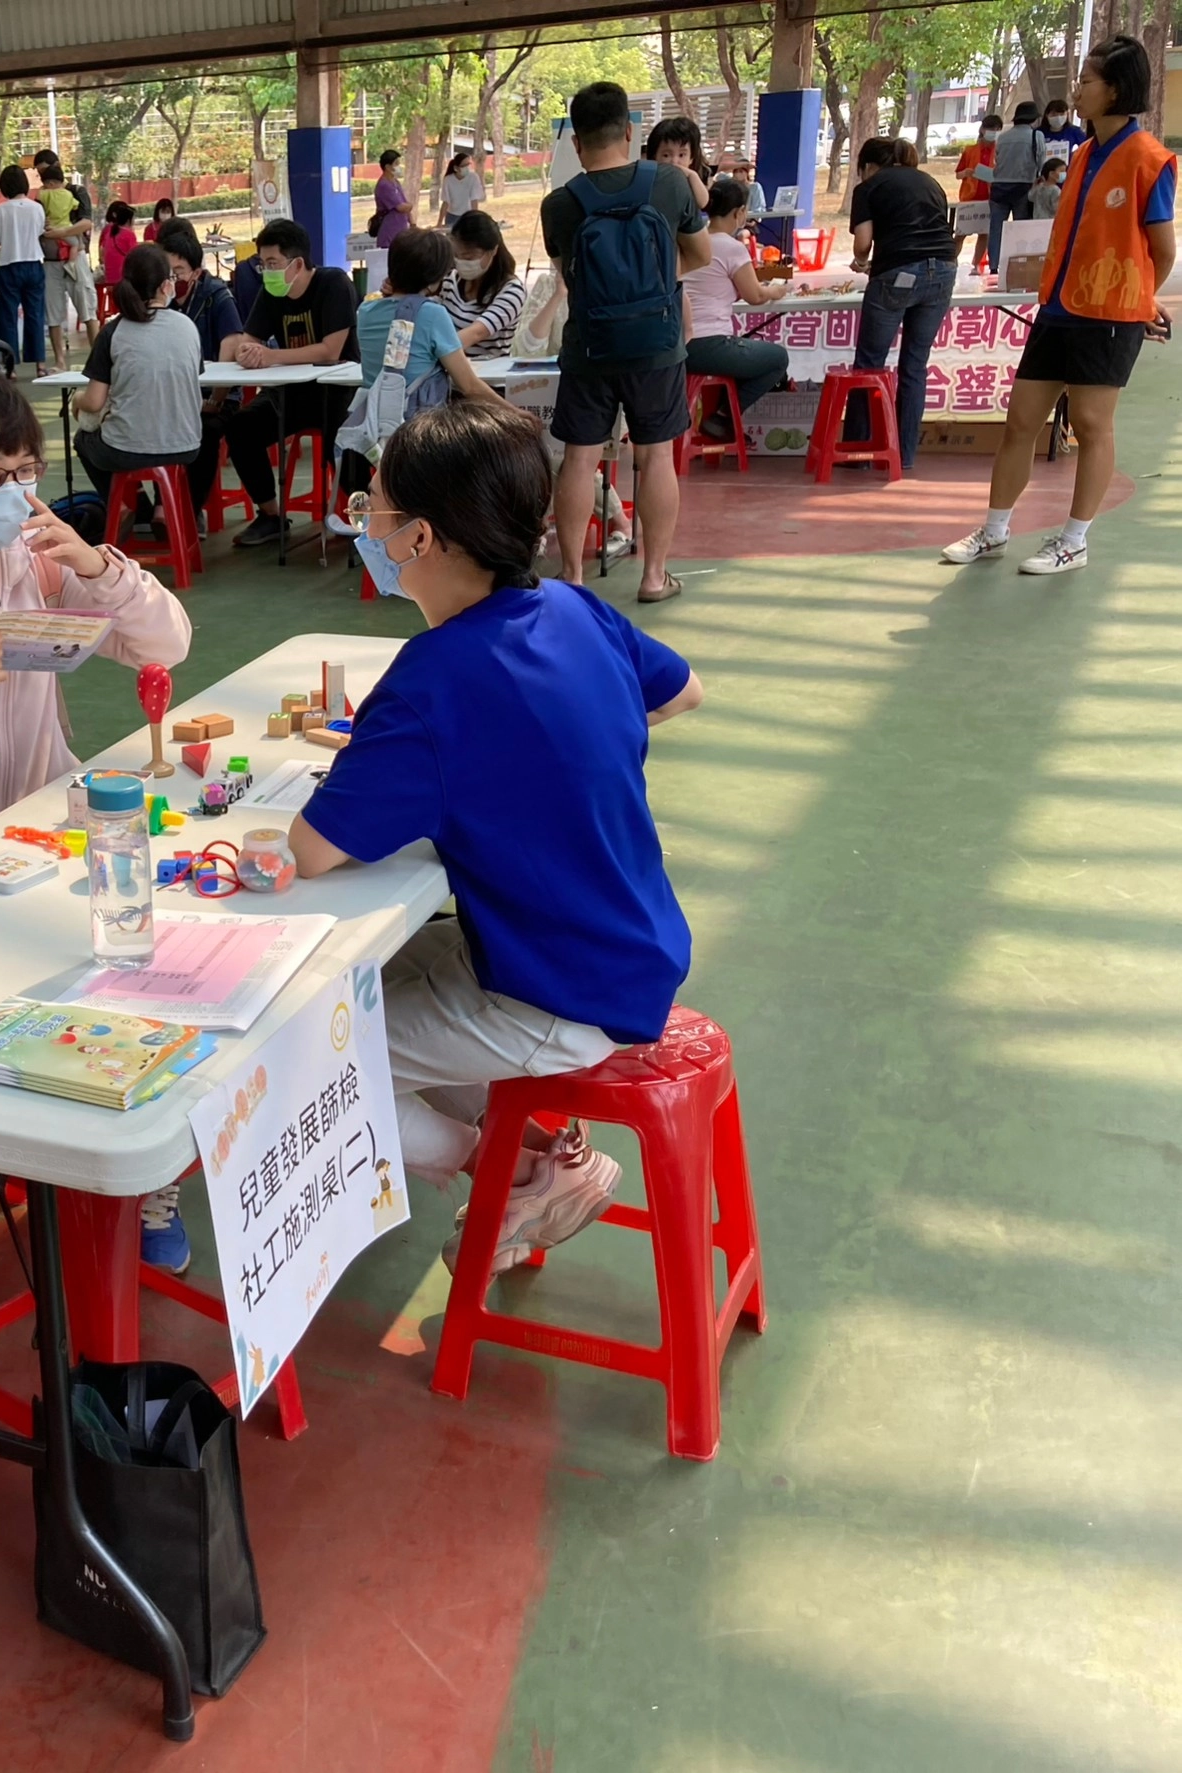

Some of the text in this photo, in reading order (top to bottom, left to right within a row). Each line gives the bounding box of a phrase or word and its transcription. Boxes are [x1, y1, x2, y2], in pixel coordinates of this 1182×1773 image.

[239, 1061, 360, 1232] 兒童發展篩檢
[240, 1121, 376, 1313] 社工施測桌(二)
